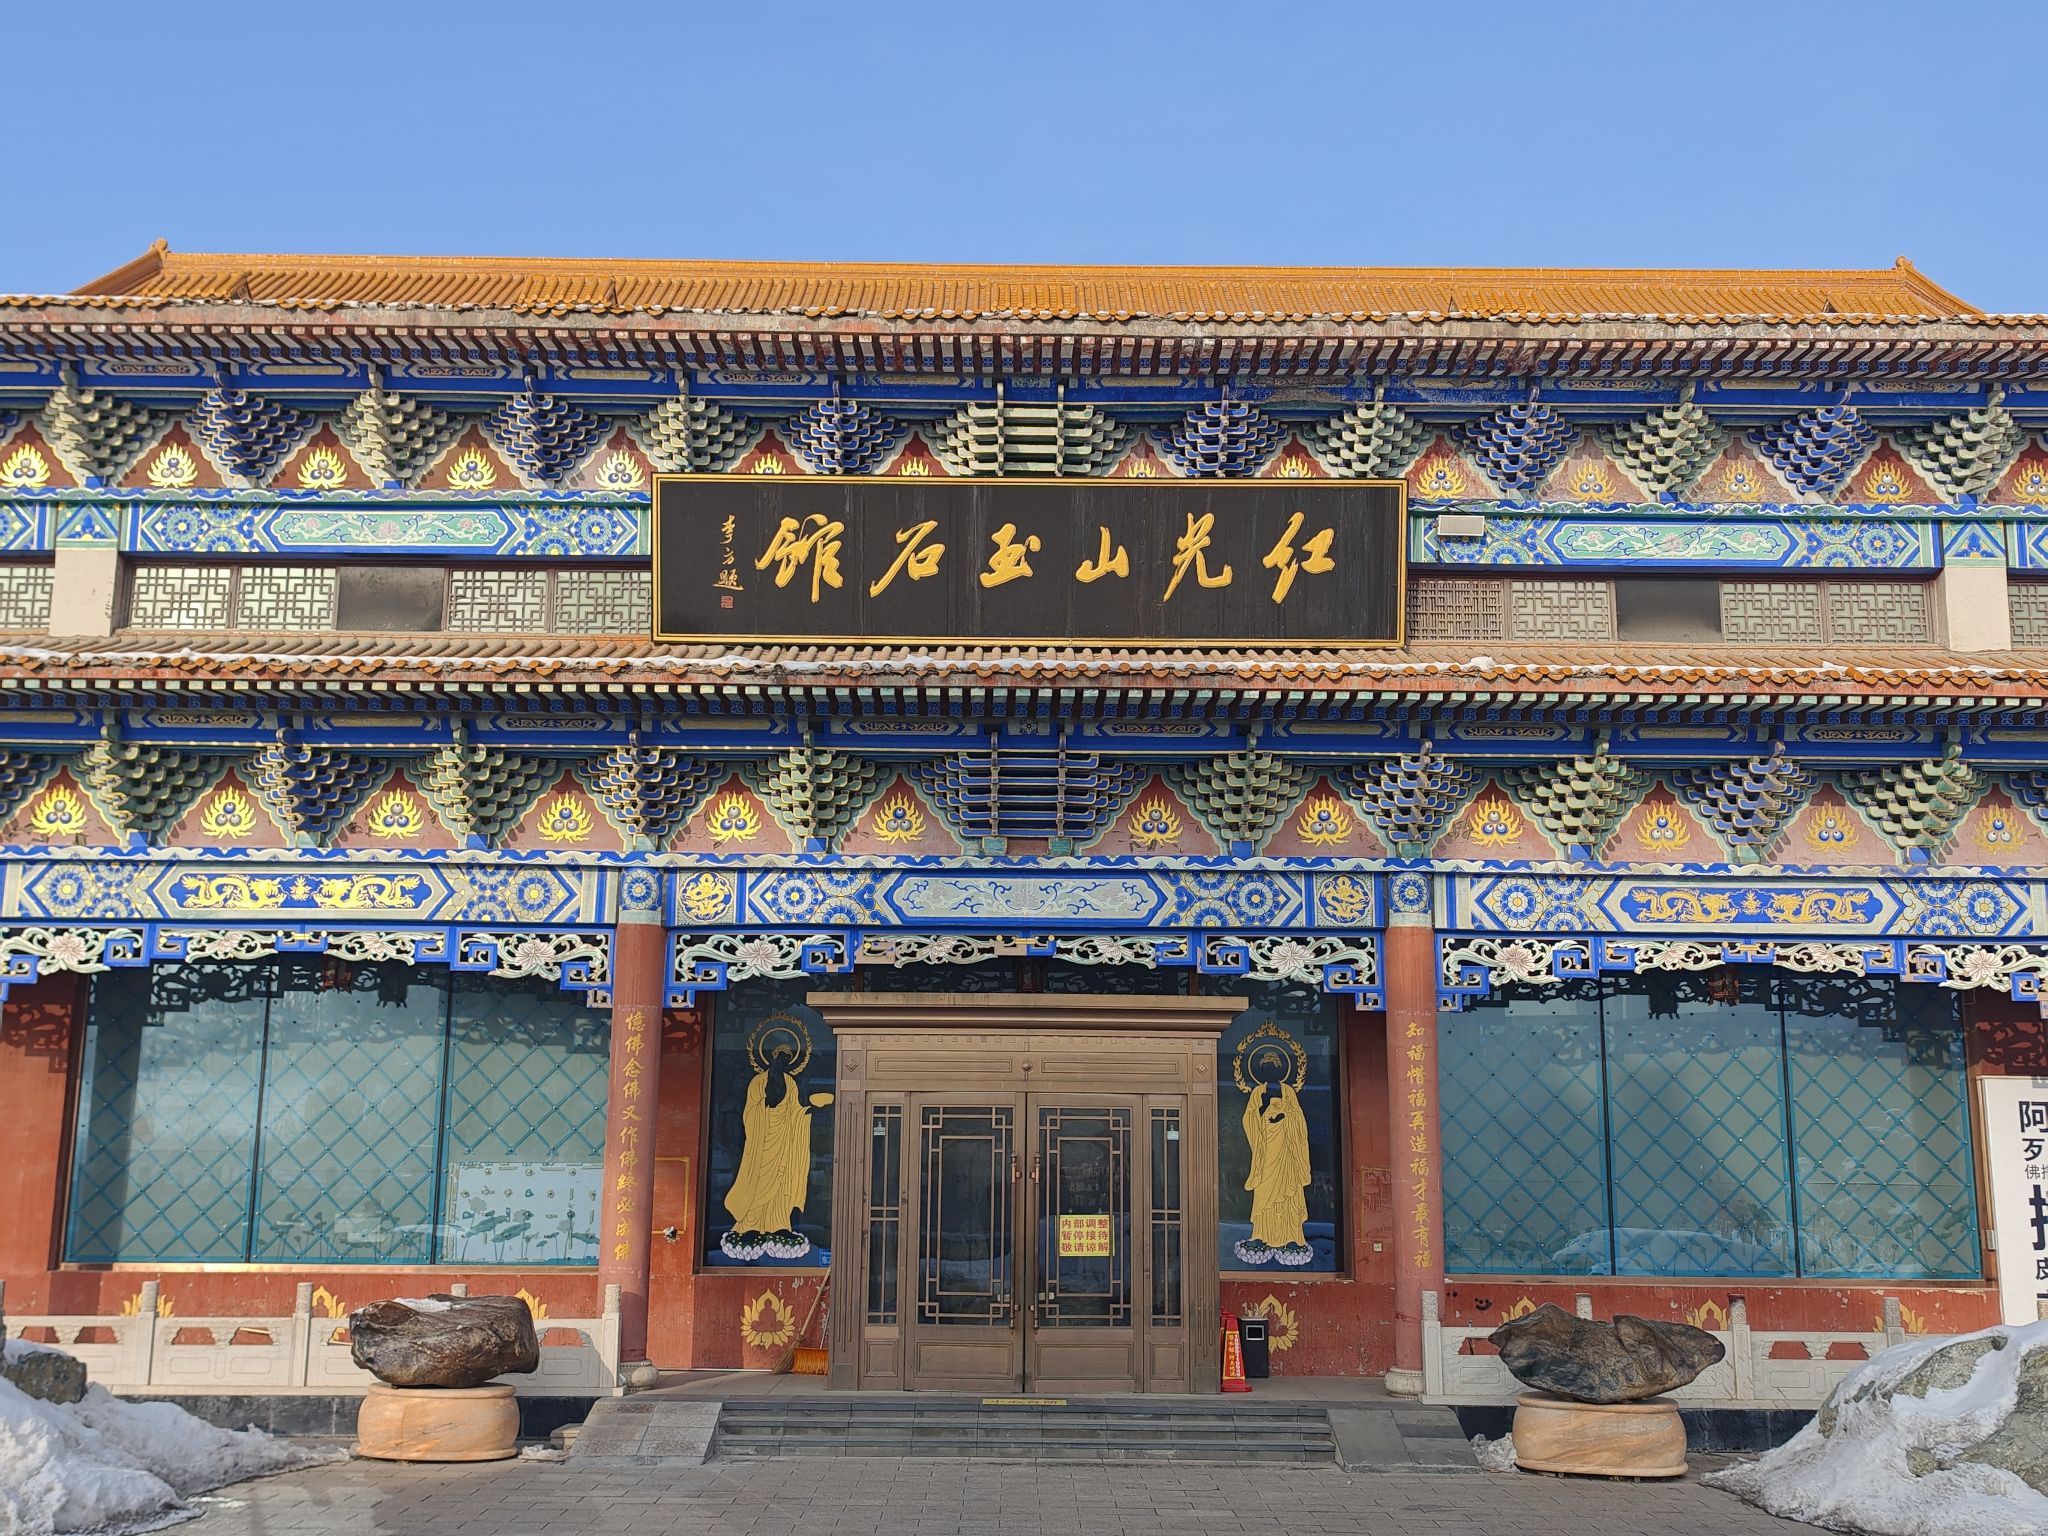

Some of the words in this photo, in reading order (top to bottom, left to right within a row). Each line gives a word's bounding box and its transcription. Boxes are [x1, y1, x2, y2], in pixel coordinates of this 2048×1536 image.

[1061, 1218, 1109, 1229] 内部调整
[1061, 1230, 1109, 1241] 暂停接待
[1061, 1242, 1109, 1253] 敬请谅解
